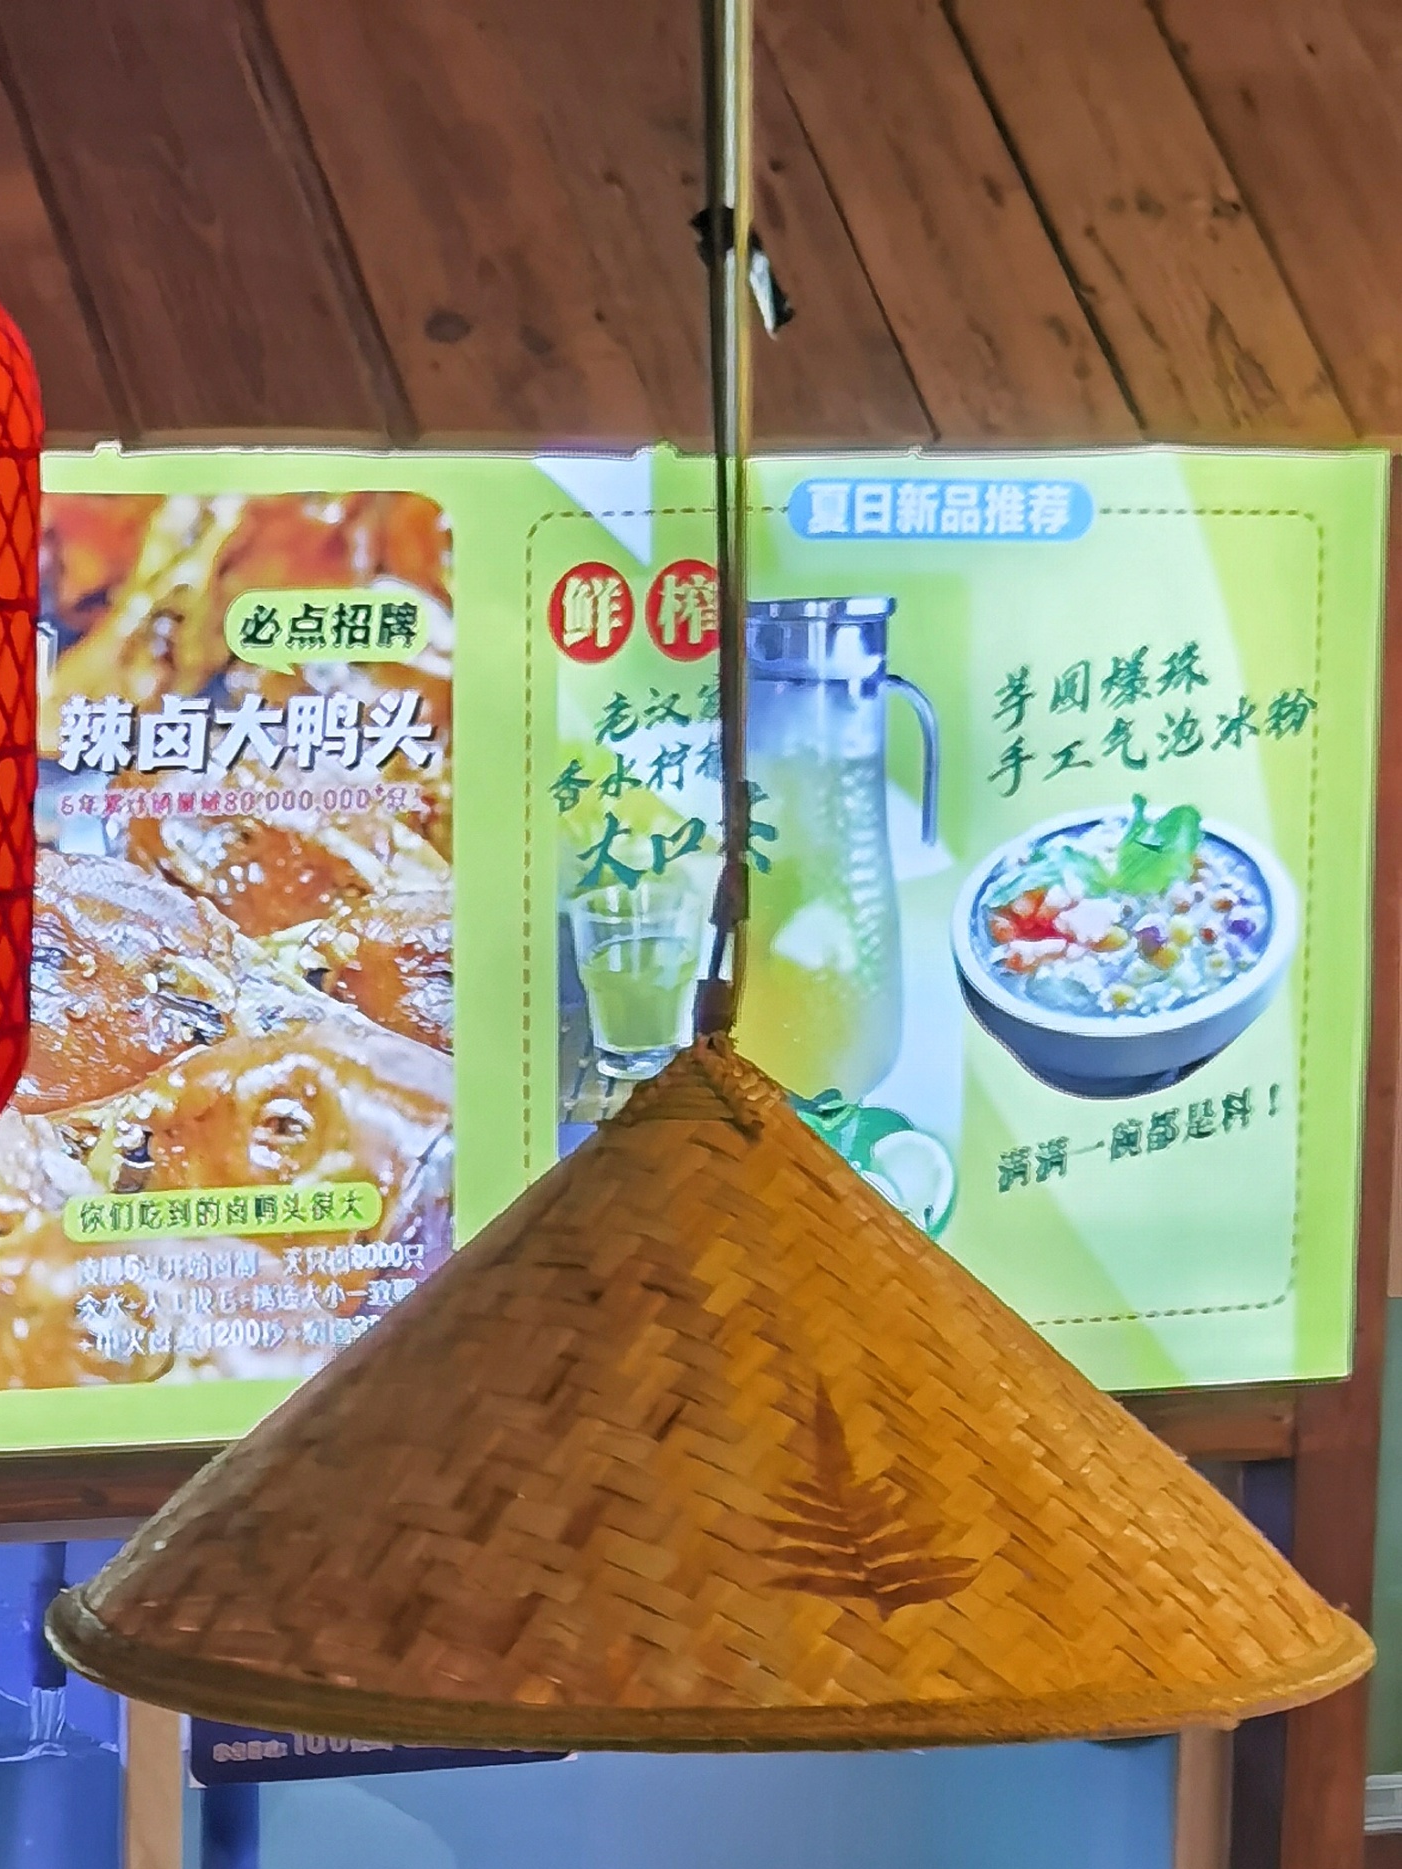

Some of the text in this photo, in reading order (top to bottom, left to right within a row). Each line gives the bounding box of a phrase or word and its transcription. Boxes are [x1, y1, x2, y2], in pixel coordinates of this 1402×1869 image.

[806, 482, 1072, 535] 夏日新品推荐
[239, 603, 419, 650] 必点招牌
[992, 642, 1210, 734] 芋圆爆珠
[58, 693, 436, 773] 辣卤大鸭头
[988, 688, 1318, 797] 手工气泡冰粉
